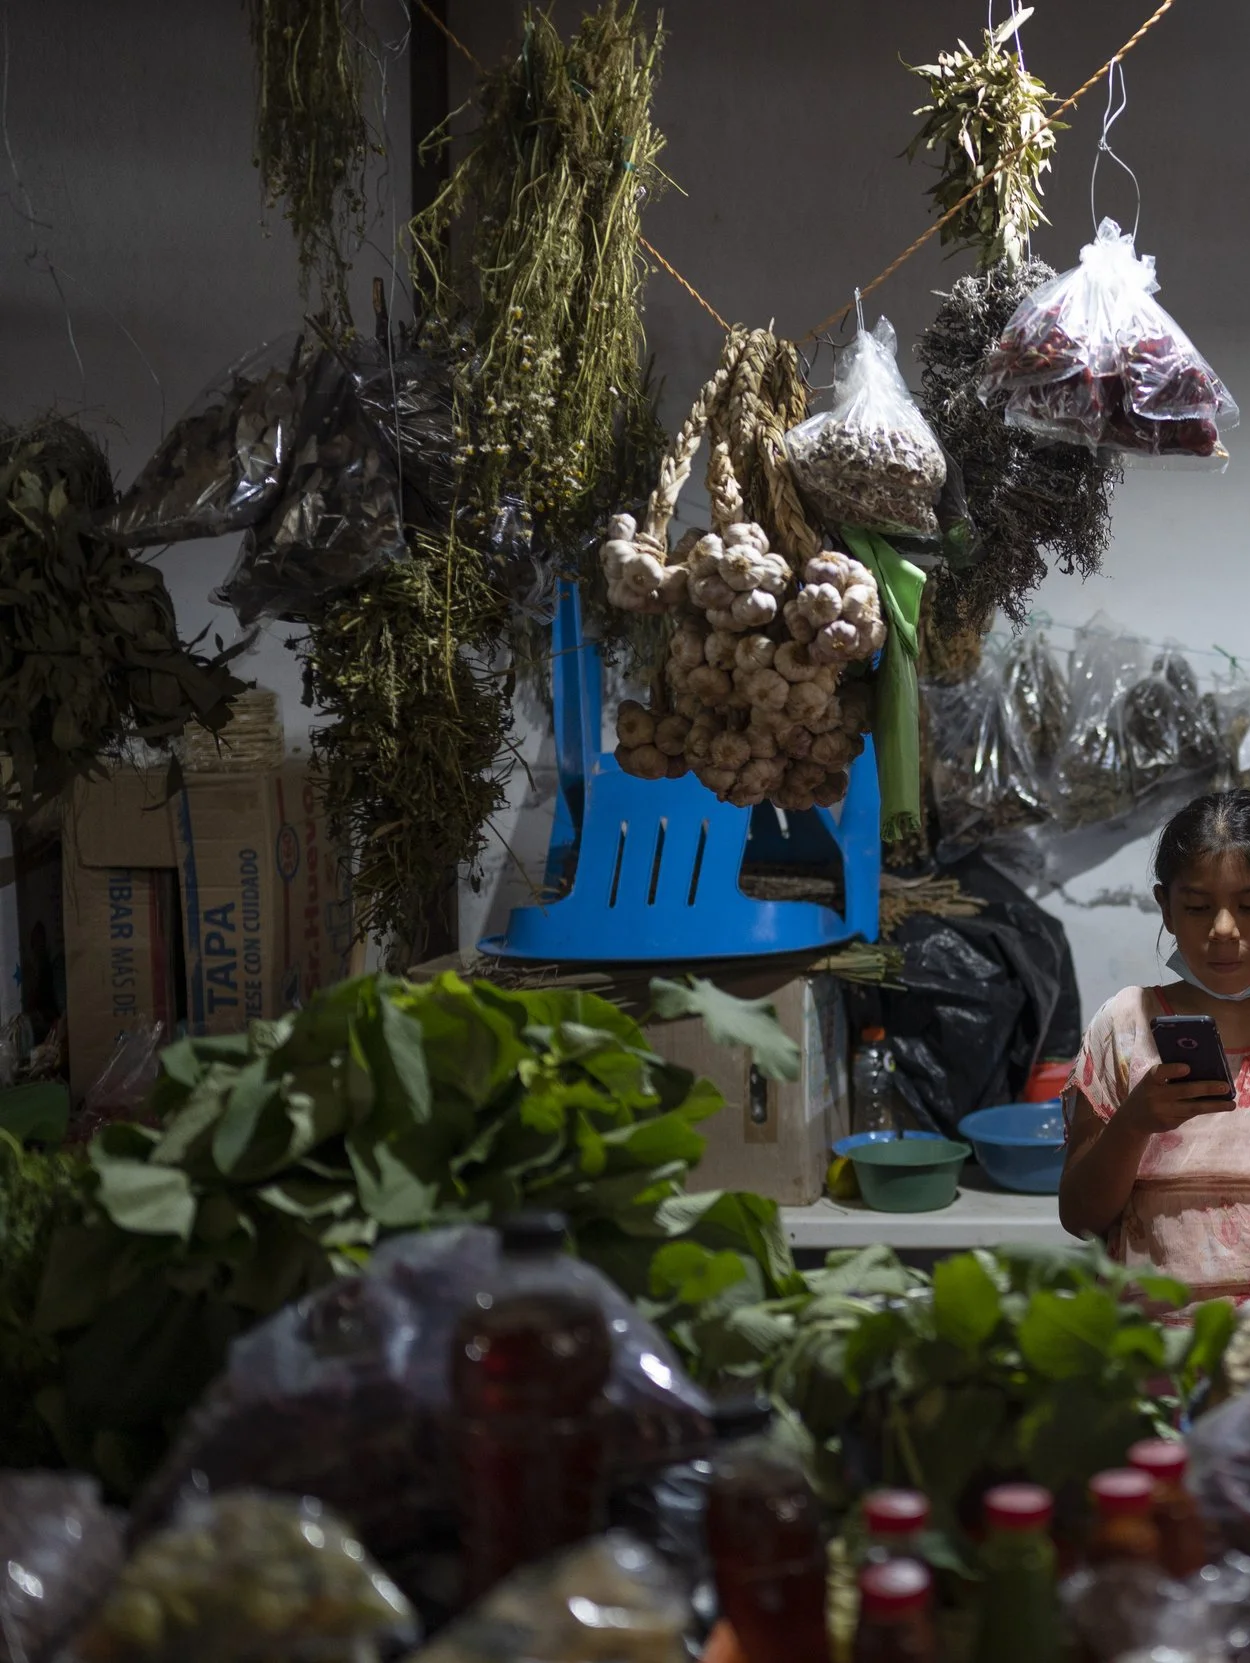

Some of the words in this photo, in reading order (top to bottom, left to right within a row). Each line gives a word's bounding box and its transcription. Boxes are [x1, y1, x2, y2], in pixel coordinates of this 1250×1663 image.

[239, 848, 261, 932] CUIDADO
[110, 946, 139, 989] MÁS
[203, 902, 239, 1014] TAPA
[243, 938, 262, 975] CON
[112, 993, 137, 1018] DE
